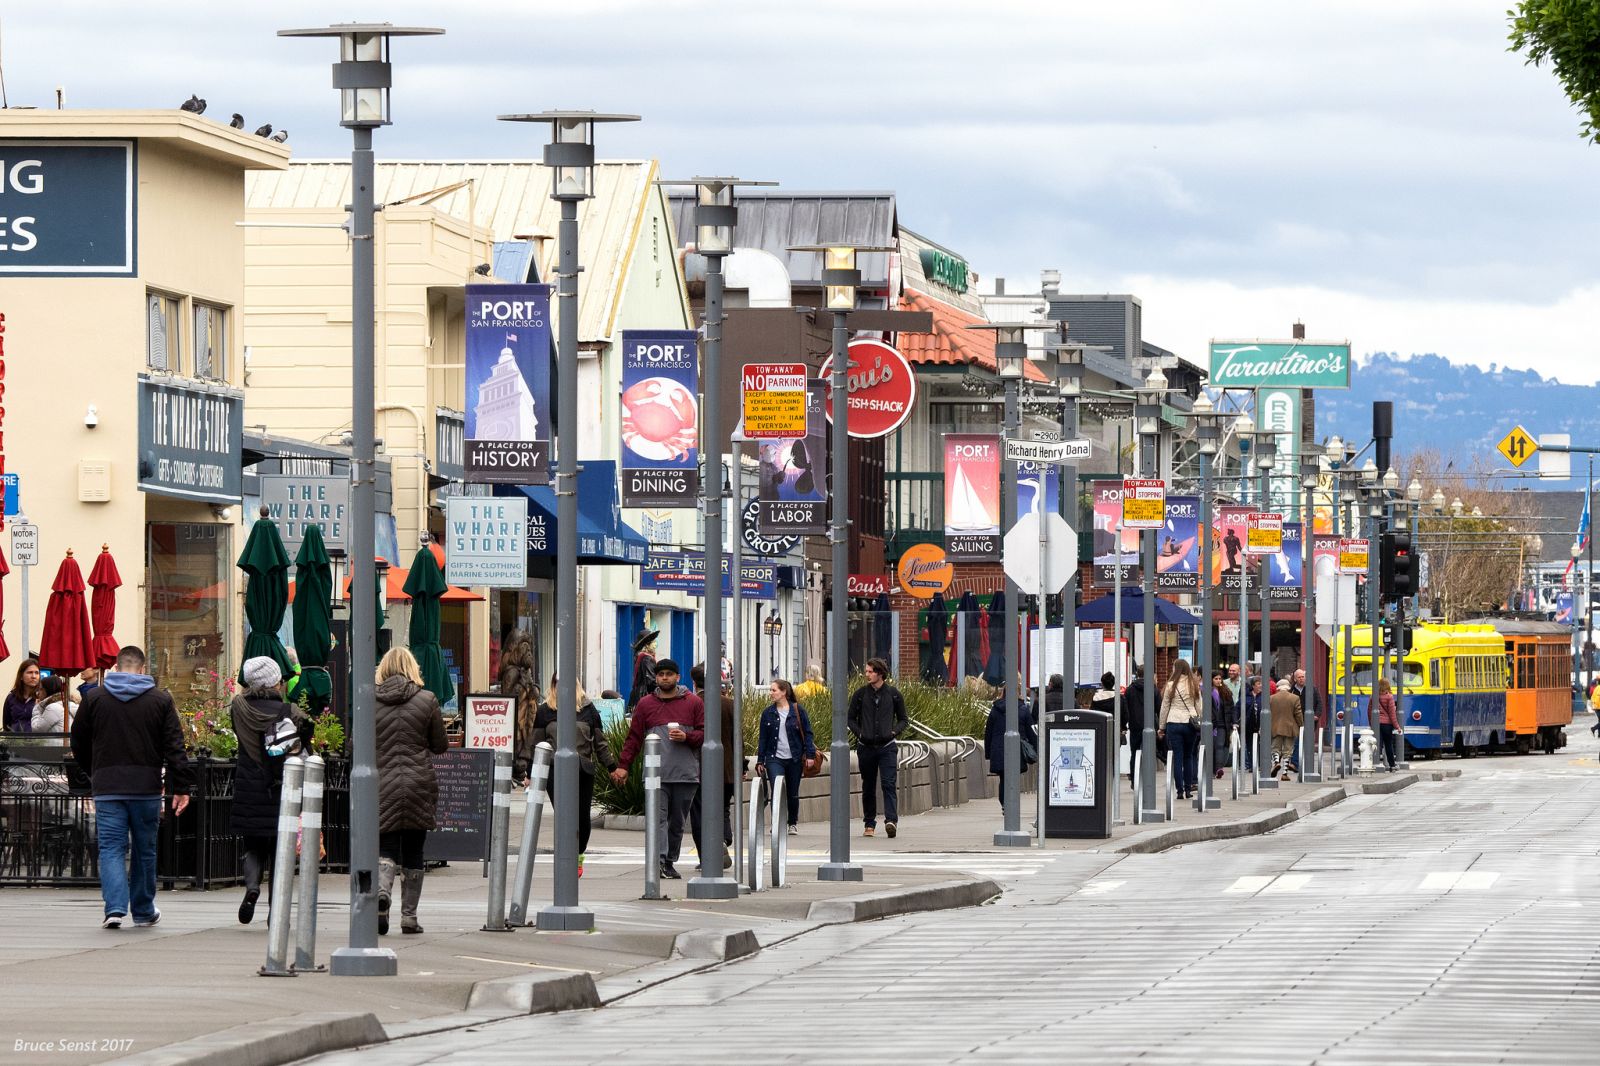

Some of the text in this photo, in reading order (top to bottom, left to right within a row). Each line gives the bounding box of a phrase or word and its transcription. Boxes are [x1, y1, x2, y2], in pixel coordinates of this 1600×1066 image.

[0, 160, 44, 194] G
[481, 301, 535, 320] PORT
[471, 319, 543, 328] SAN FRANCISCO
[636, 345, 685, 362] PORT
[627, 361, 692, 369] SAN FRANCISCO
[1213, 345, 1345, 382] Tarantino's
[755, 366, 794, 374] TOW-AWAY
[846, 356, 893, 393] ou's
[745, 374, 804, 391] NO PARKING
[848, 397, 904, 413] FISH SHACK
[152, 391, 230, 454] THE WHARF STORE
[1040, 431, 1059, 440] 2900
[516, 442, 534, 450] FOR
[955, 444, 990, 458] PORT
[1008, 443, 1089, 459] Richard Henry Dana
[471, 451, 541, 467] HISTORY
[1017, 460, 1047, 470] PO
[631, 478, 687, 493] DINING
[287, 484, 326, 501] THE
[1102, 489, 1124, 501] POR
[1124, 487, 1135, 499] NO
[268, 502, 345, 520] WHARF
[470, 505, 505, 521] THE
[1165, 504, 1192, 515] PORT
[771, 510, 813, 523] LABOR
[1226, 513, 1248, 523] POR
[452, 521, 522, 537] WHARF
[1248, 519, 1258, 529] NO
[13, 530, 37, 538] MOTOR-
[1281, 529, 1297, 538] ORT
[15, 542, 34, 550] CYCLE
[456, 537, 519, 553] STORE
[527, 540, 547, 551] NG
[951, 541, 994, 553] SAILING
[1315, 540, 1337, 549] PORT
[644, 557, 676, 569] SAFE
[740, 568, 773, 581] RBOR
[1104, 569, 1129, 579] SHPS
[847, 576, 884, 596] Lou's
[1160, 577, 1196, 586] BOATING
[1225, 580, 1253, 588] SPOTS
[1270, 590, 1299, 598] FISHING
[1192, 606, 1203, 614] Wa
[481, 726, 500, 734] SALE
[473, 735, 480, 747] 2
